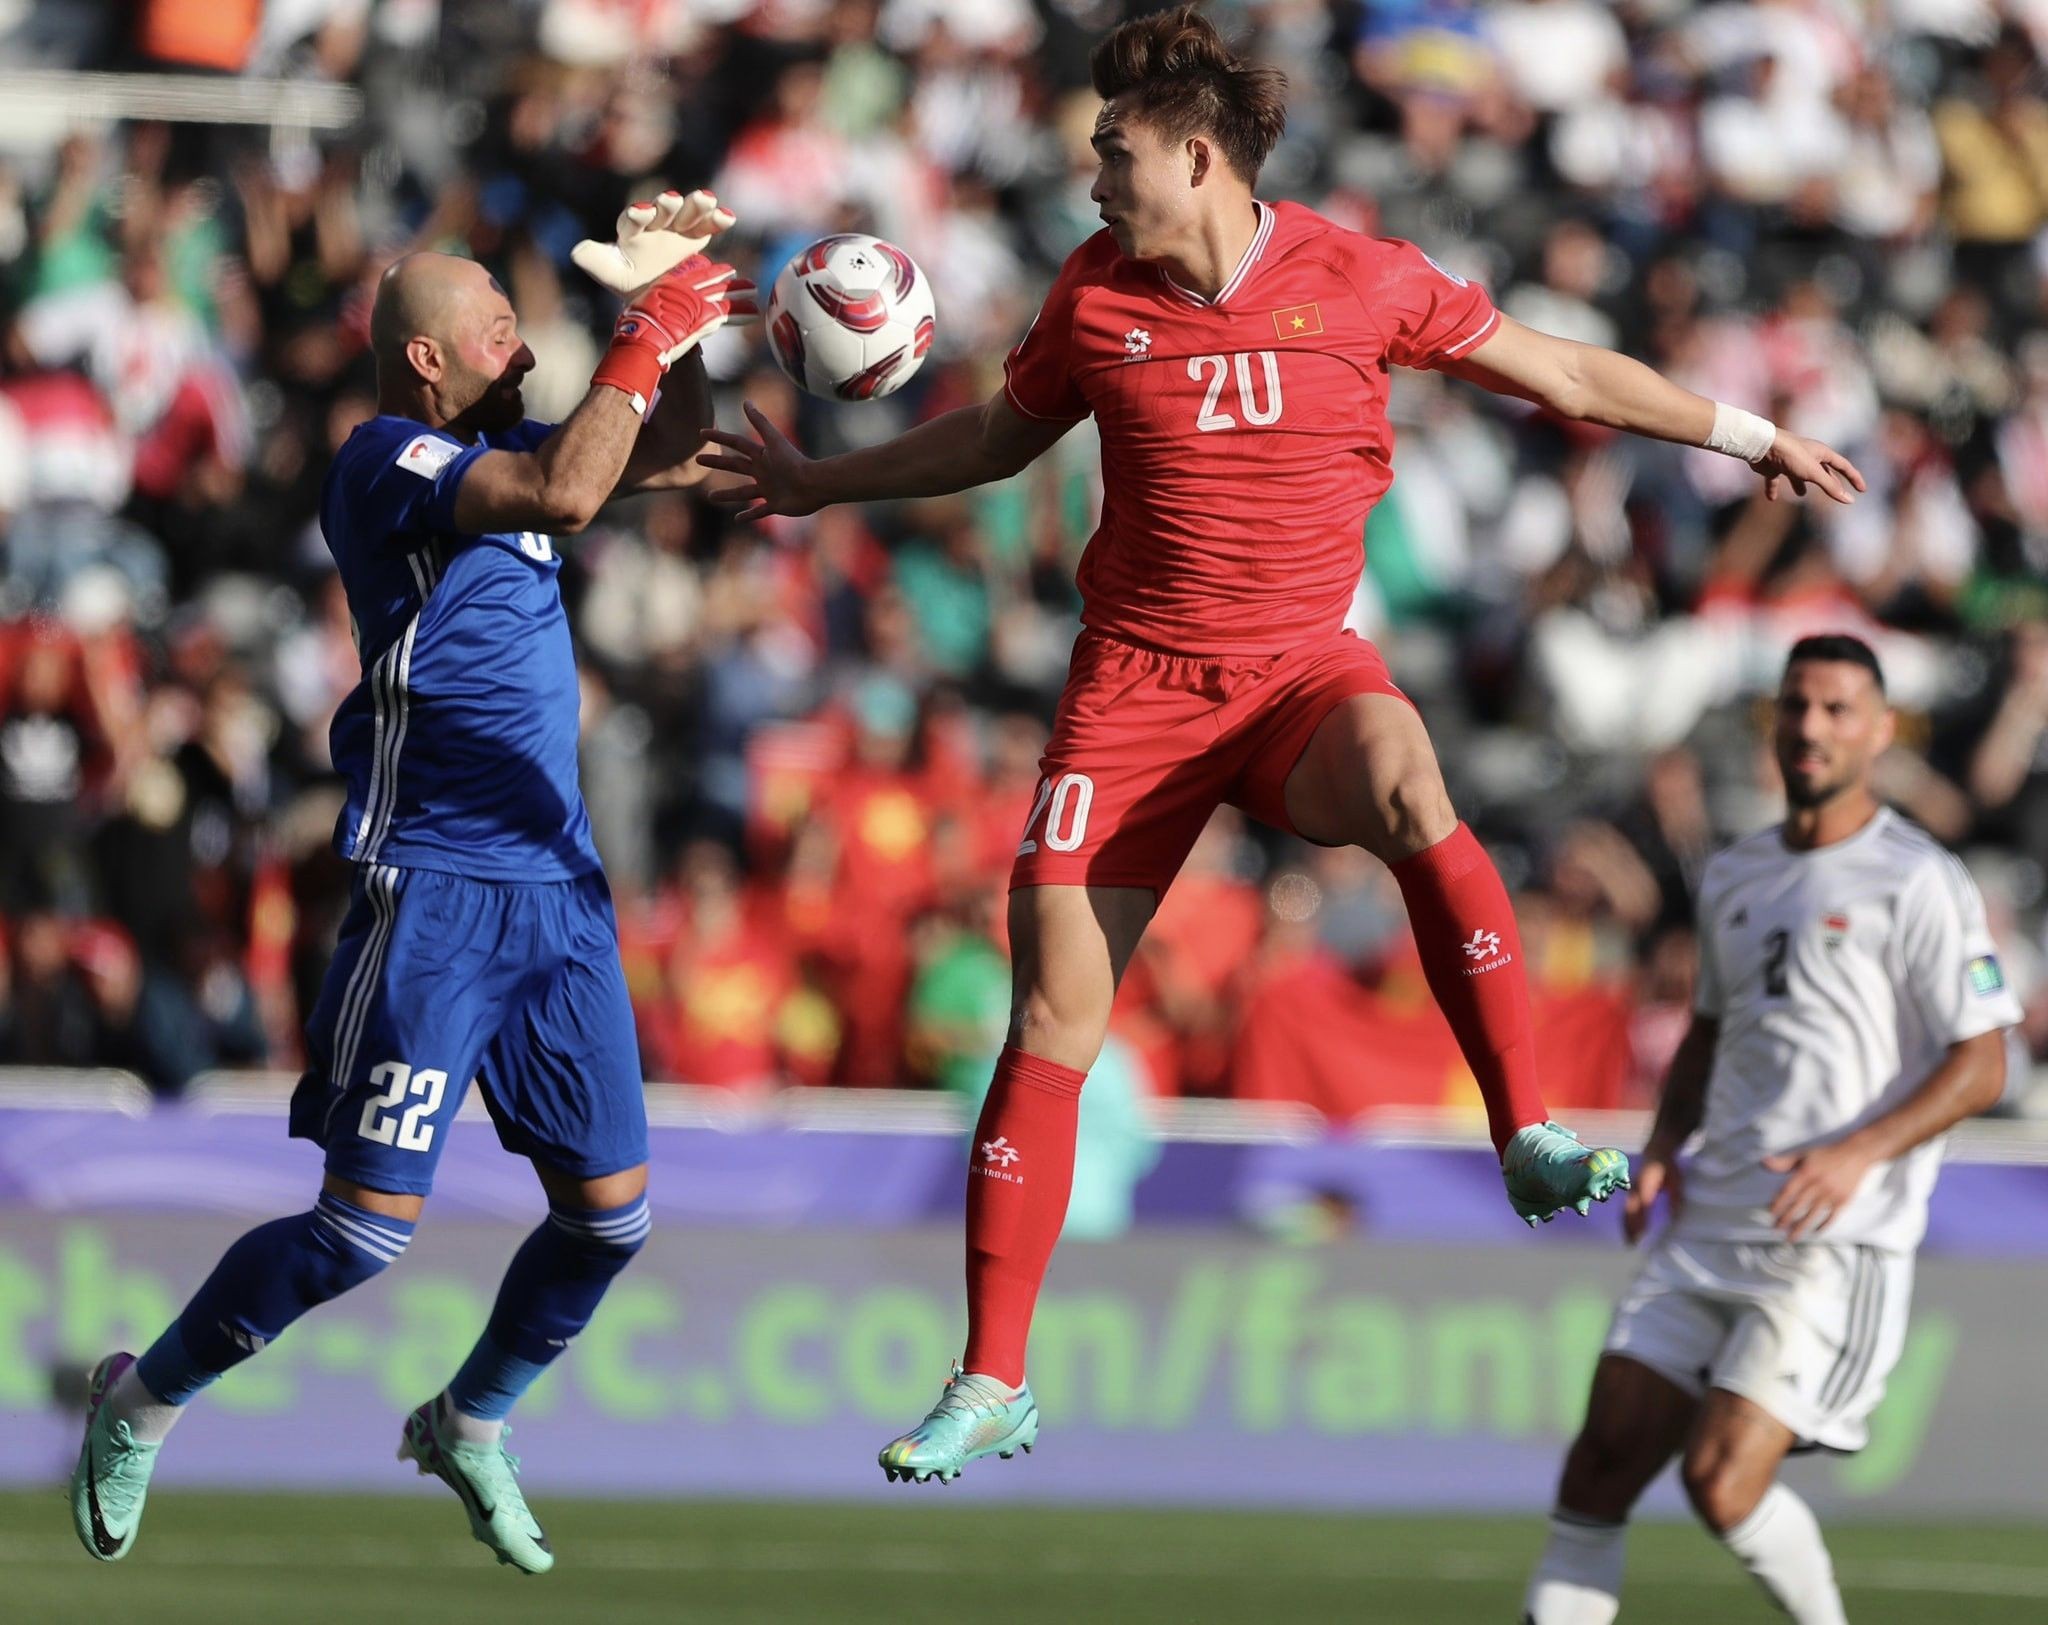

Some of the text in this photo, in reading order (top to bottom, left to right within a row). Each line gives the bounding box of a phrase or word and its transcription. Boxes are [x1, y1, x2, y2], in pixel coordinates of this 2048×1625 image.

[1187, 351, 1283, 431] 20
[1763, 926, 1790, 996] 2
[358, 1060, 448, 1152] 22
